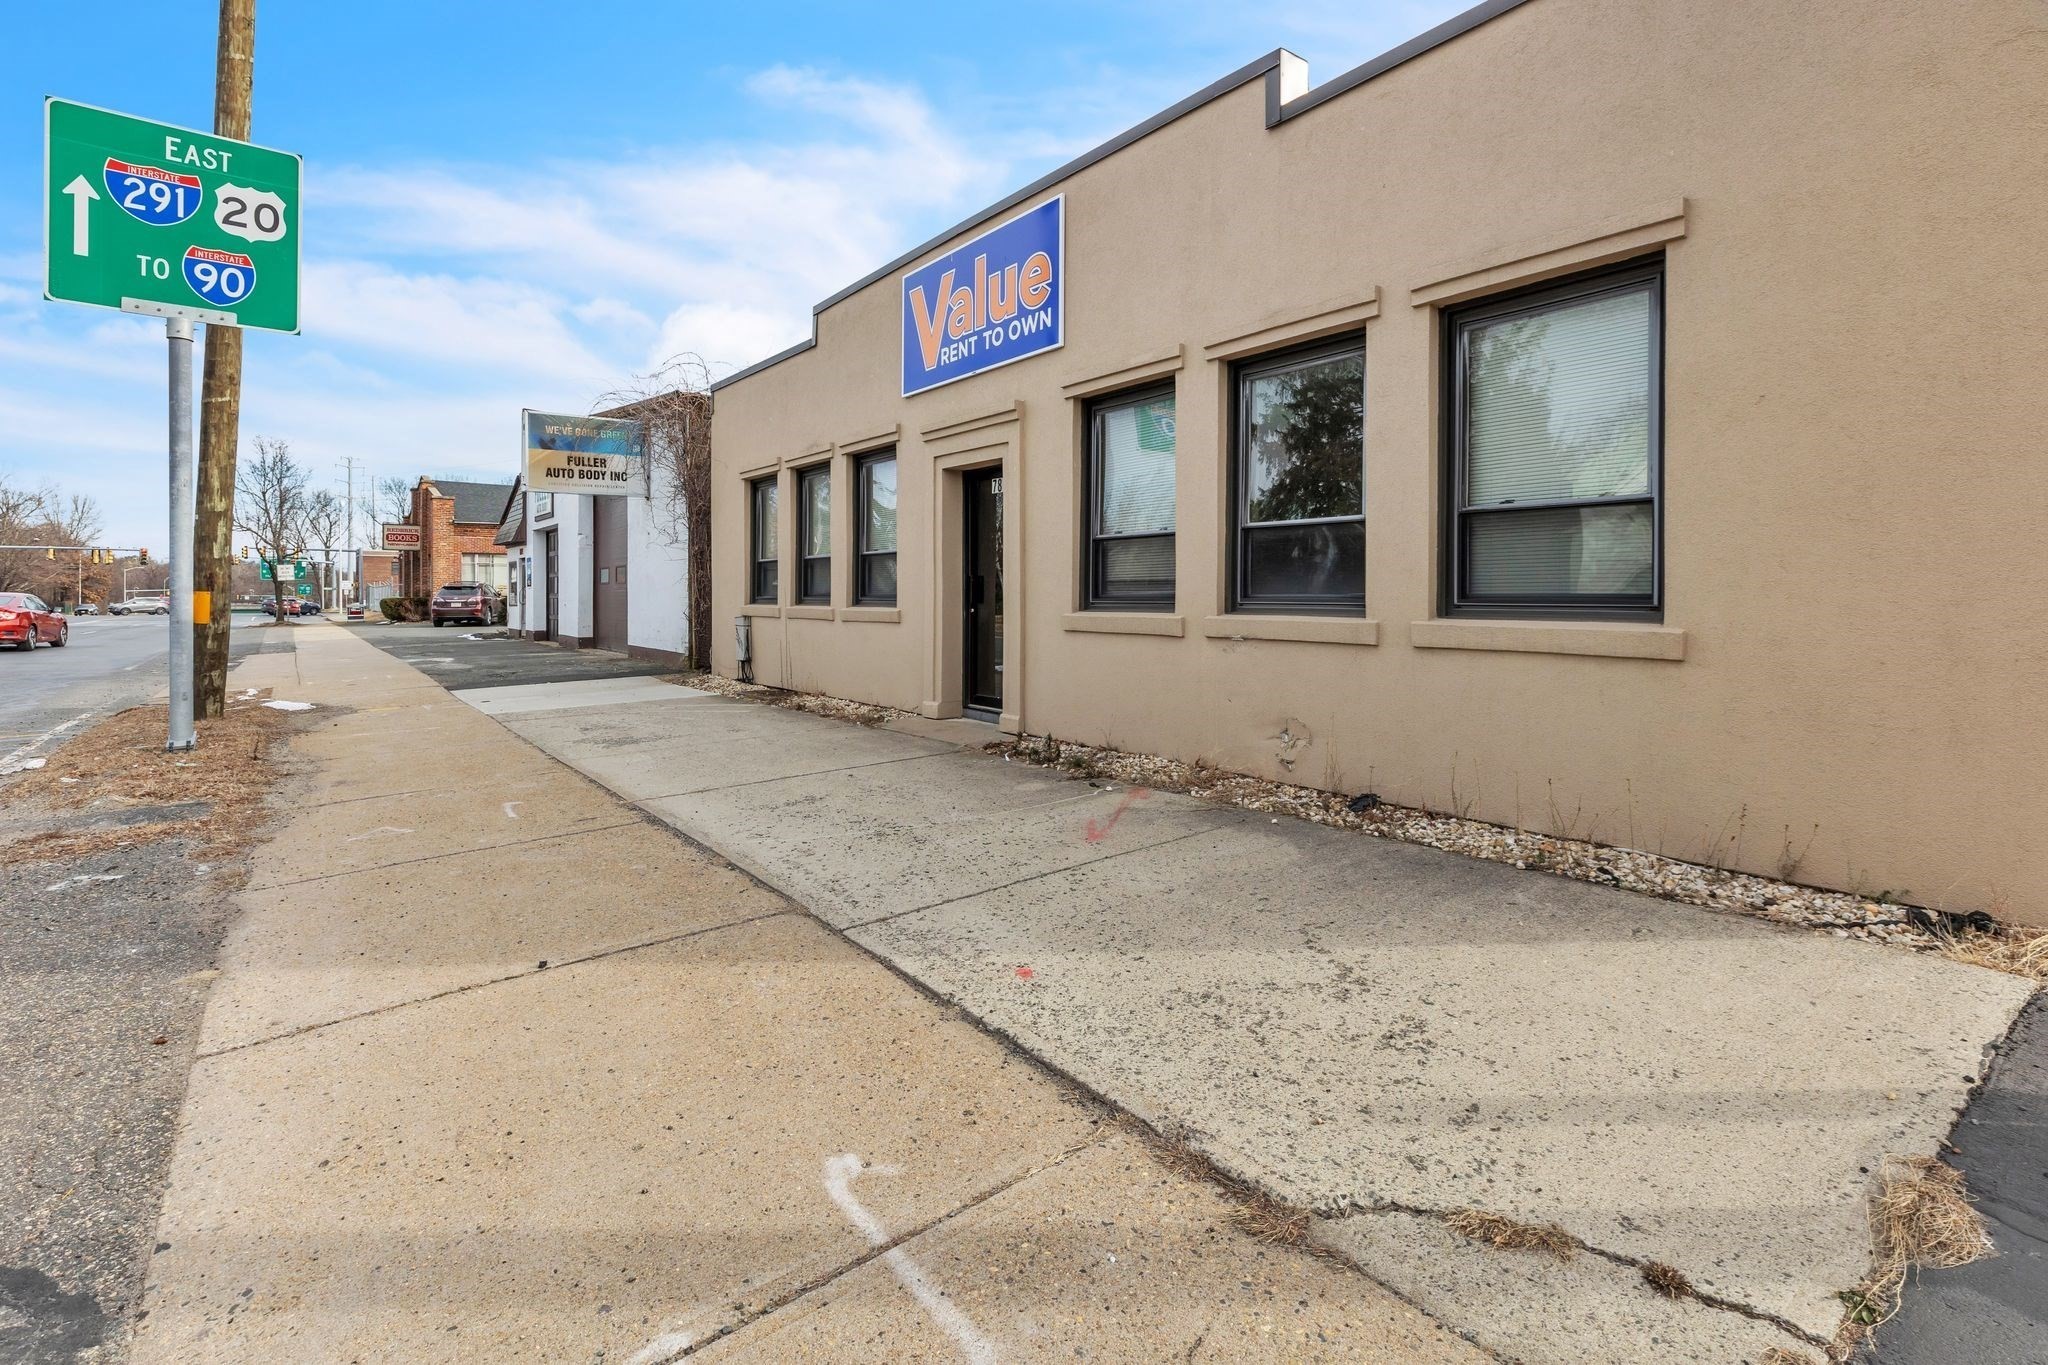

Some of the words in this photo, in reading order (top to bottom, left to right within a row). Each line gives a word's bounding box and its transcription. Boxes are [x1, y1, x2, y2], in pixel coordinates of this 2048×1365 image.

[165, 135, 232, 172] EAST
[127, 165, 181, 184] INTERSTATE
[123, 177, 184, 218] 291
[221, 196, 280, 233] 20
[136, 255, 170, 280] TO
[194, 250, 245, 265] INTERSTATE
[193, 263, 245, 298] 90
[909, 251, 1052, 372] Value
[941, 336, 978, 366] RENT
[982, 327, 1004, 350] TO
[1008, 307, 1052, 340] OWN
[545, 425, 573, 436] WE'VE
[545, 467, 575, 479] AUTO
[578, 469, 607, 481] BODY
[610, 471, 628, 482] INC
[567, 456, 607, 469] FULLER
[388, 534, 418, 542] BOOKS
